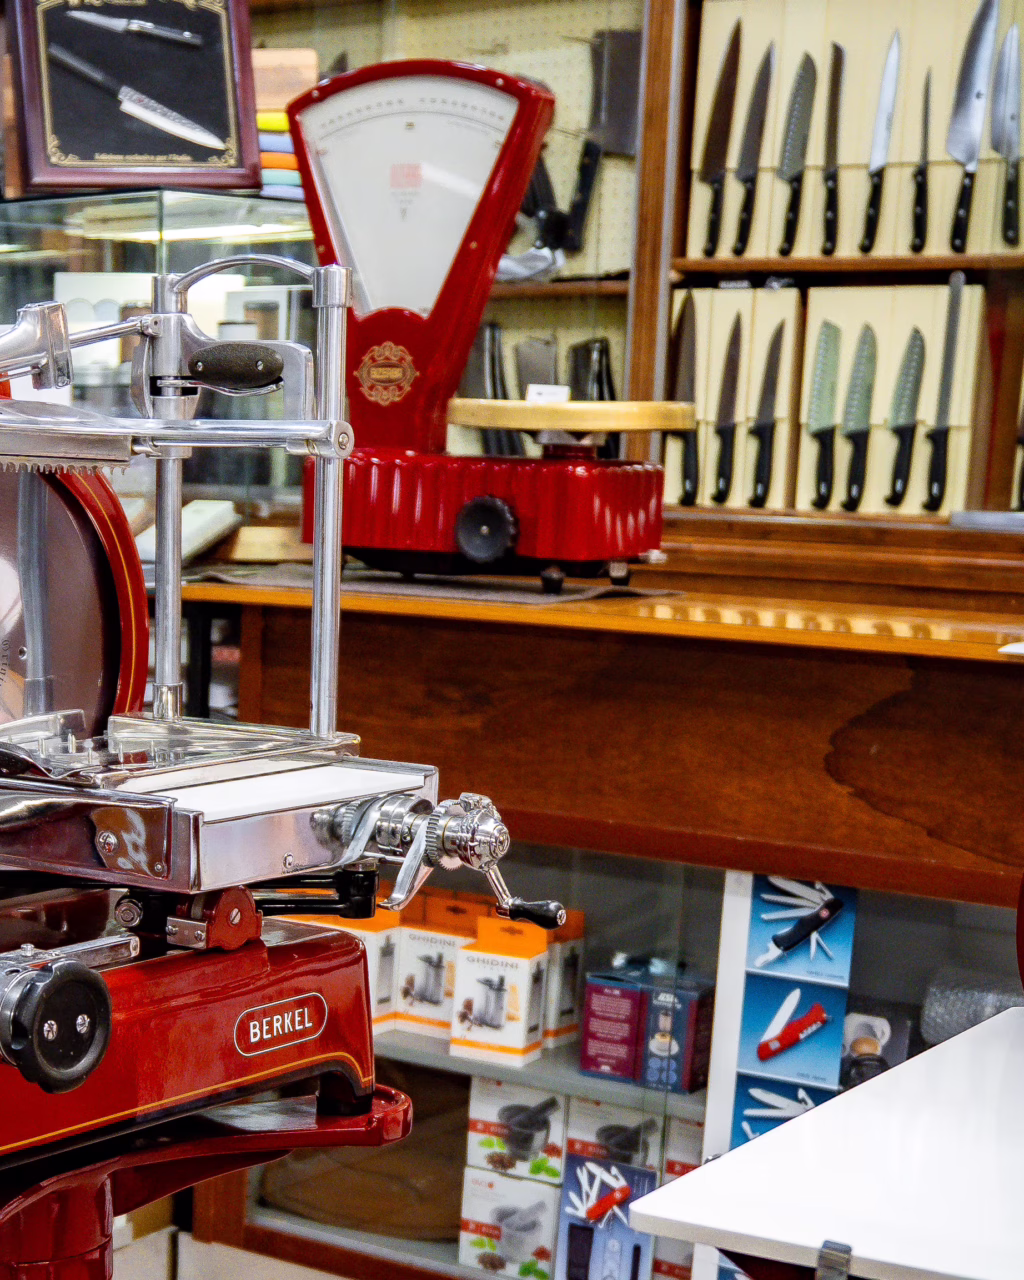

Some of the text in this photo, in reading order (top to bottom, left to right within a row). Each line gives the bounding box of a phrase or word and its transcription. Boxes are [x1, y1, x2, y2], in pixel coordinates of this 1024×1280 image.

[408, 933, 456, 948] GHIDINI
[466, 955, 519, 970] GHIDINI
[249, 1007, 313, 1043] BERKEL
